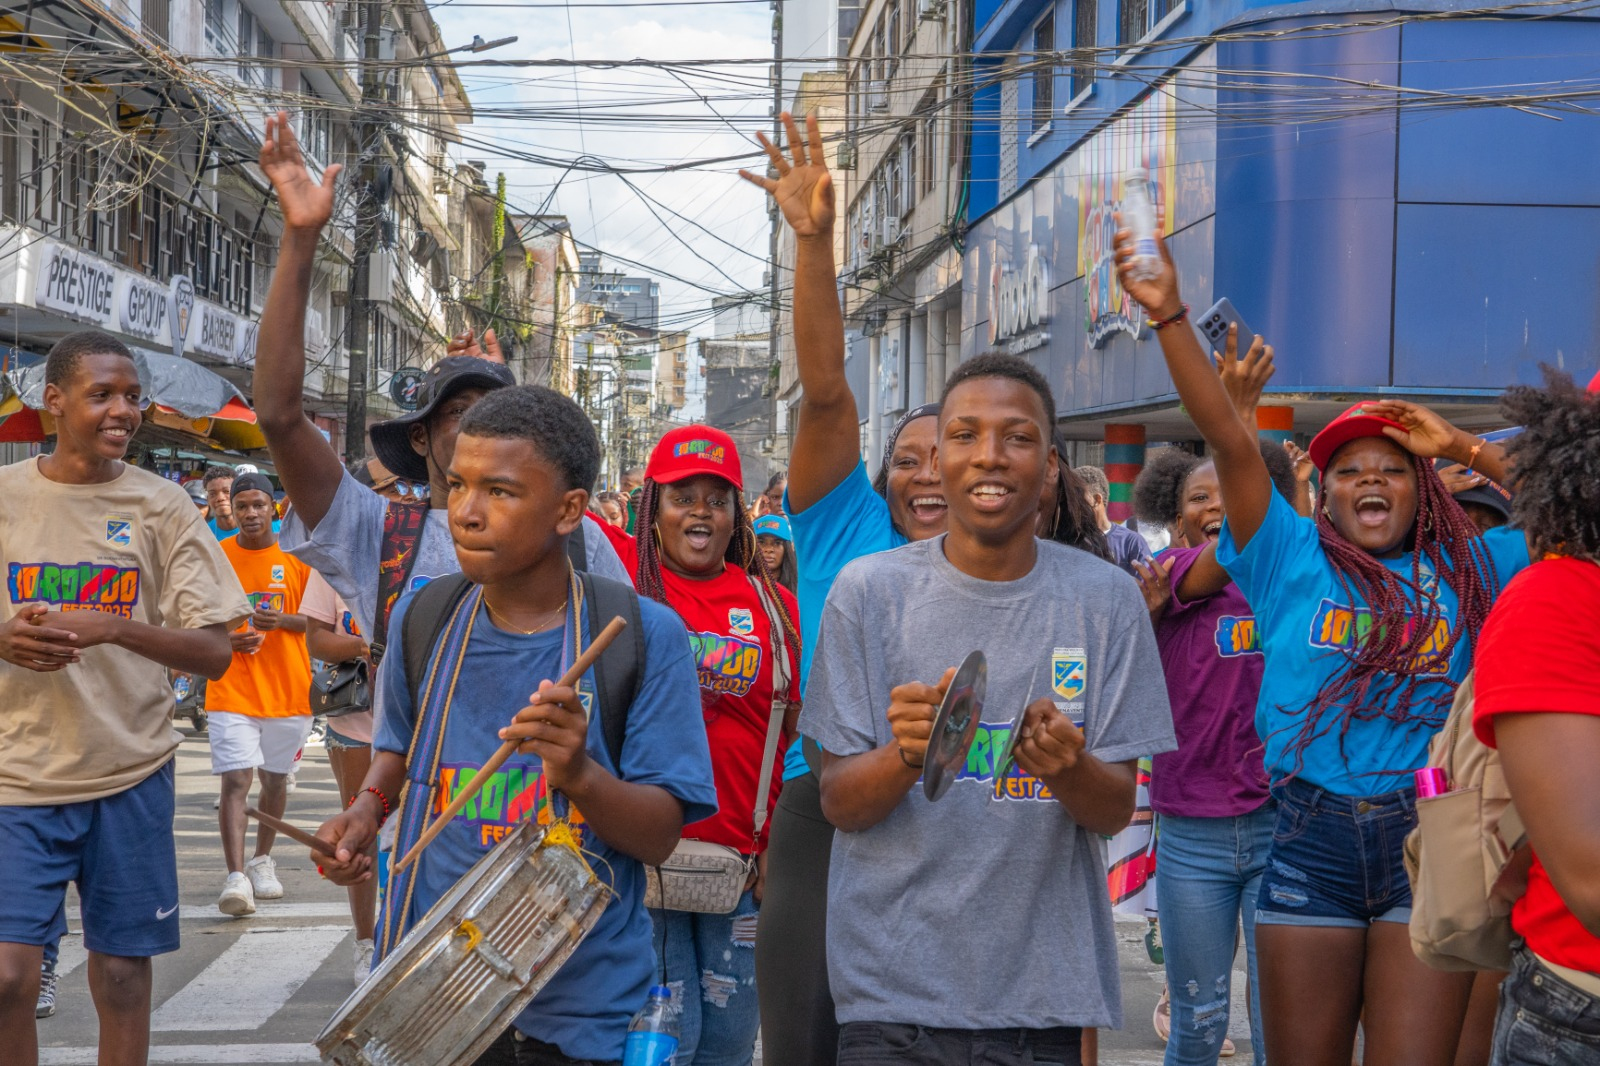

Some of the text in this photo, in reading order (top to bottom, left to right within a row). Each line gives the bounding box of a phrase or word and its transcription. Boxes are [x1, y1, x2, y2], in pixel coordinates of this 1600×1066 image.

[47, 254, 114, 318] PRESTIGE
[127, 284, 167, 330] GROUP
[201, 311, 236, 353] BARBER
[8, 564, 139, 604] BORONDO
